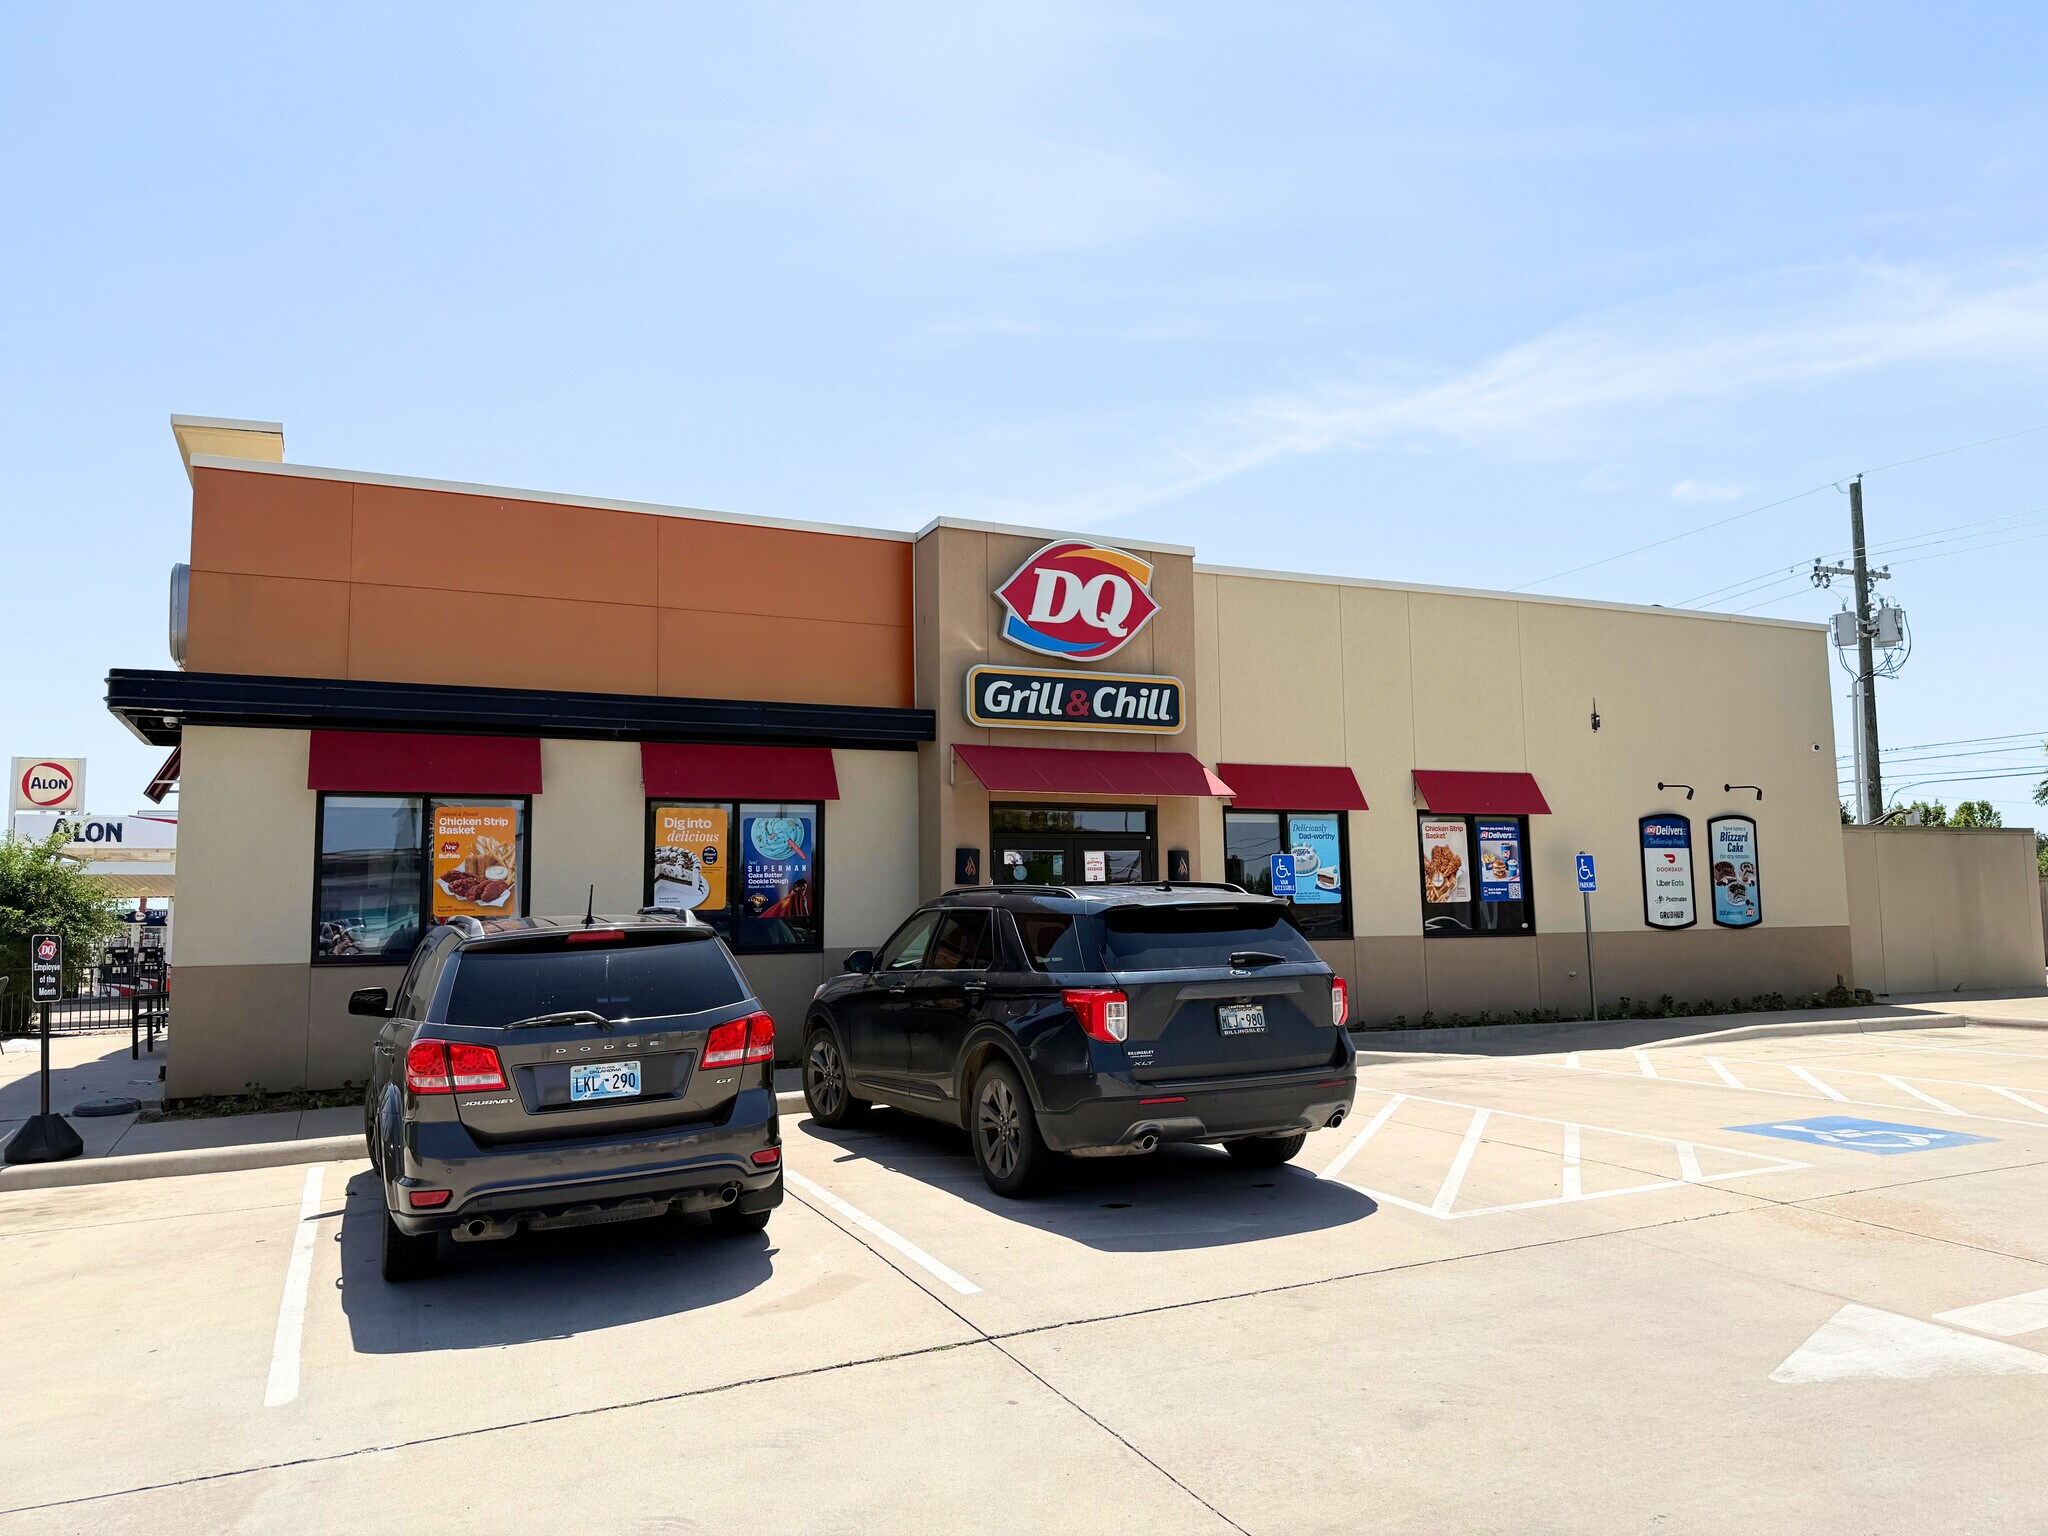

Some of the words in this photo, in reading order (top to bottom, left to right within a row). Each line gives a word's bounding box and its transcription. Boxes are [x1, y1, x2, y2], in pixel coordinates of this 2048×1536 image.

[1027, 567, 1133, 638] DQ
[984, 680, 1064, 716] Grill
[1065, 689, 1091, 717] &
[1092, 686, 1171, 720] Chill
[30, 776, 68, 790] ALON
[439, 817, 481, 826] Chicken
[483, 817, 508, 827] Strip
[664, 817, 685, 831] Dig
[687, 817, 712, 829] into
[53, 818, 123, 843] ALON
[439, 826, 475, 835] Basket
[1293, 823, 1327, 834] Deliciously
[1656, 825, 1683, 836] Delivers
[667, 830, 720, 842] delicious
[1298, 832, 1336, 841] Dad-worthy
[1720, 832, 1748, 842] Blizzard
[444, 842, 457, 850] New
[1727, 842, 1744, 853] Cake
[748, 865, 807, 873] SUPERMAN
[1660, 911, 1684, 919] GRUBHUB
[42, 945, 54, 956] DQ
[34, 962, 60, 973] Employee
[40, 976, 46, 984] of
[46, 976, 56, 984] the
[39, 987, 57, 996] Month
[1224, 1027, 1265, 1036] BILLINGSLEY
[556, 1040, 659, 1054] DODGE
[575, 1072, 636, 1094] LKL-290
[461, 1098, 516, 1107] JOURNEY
